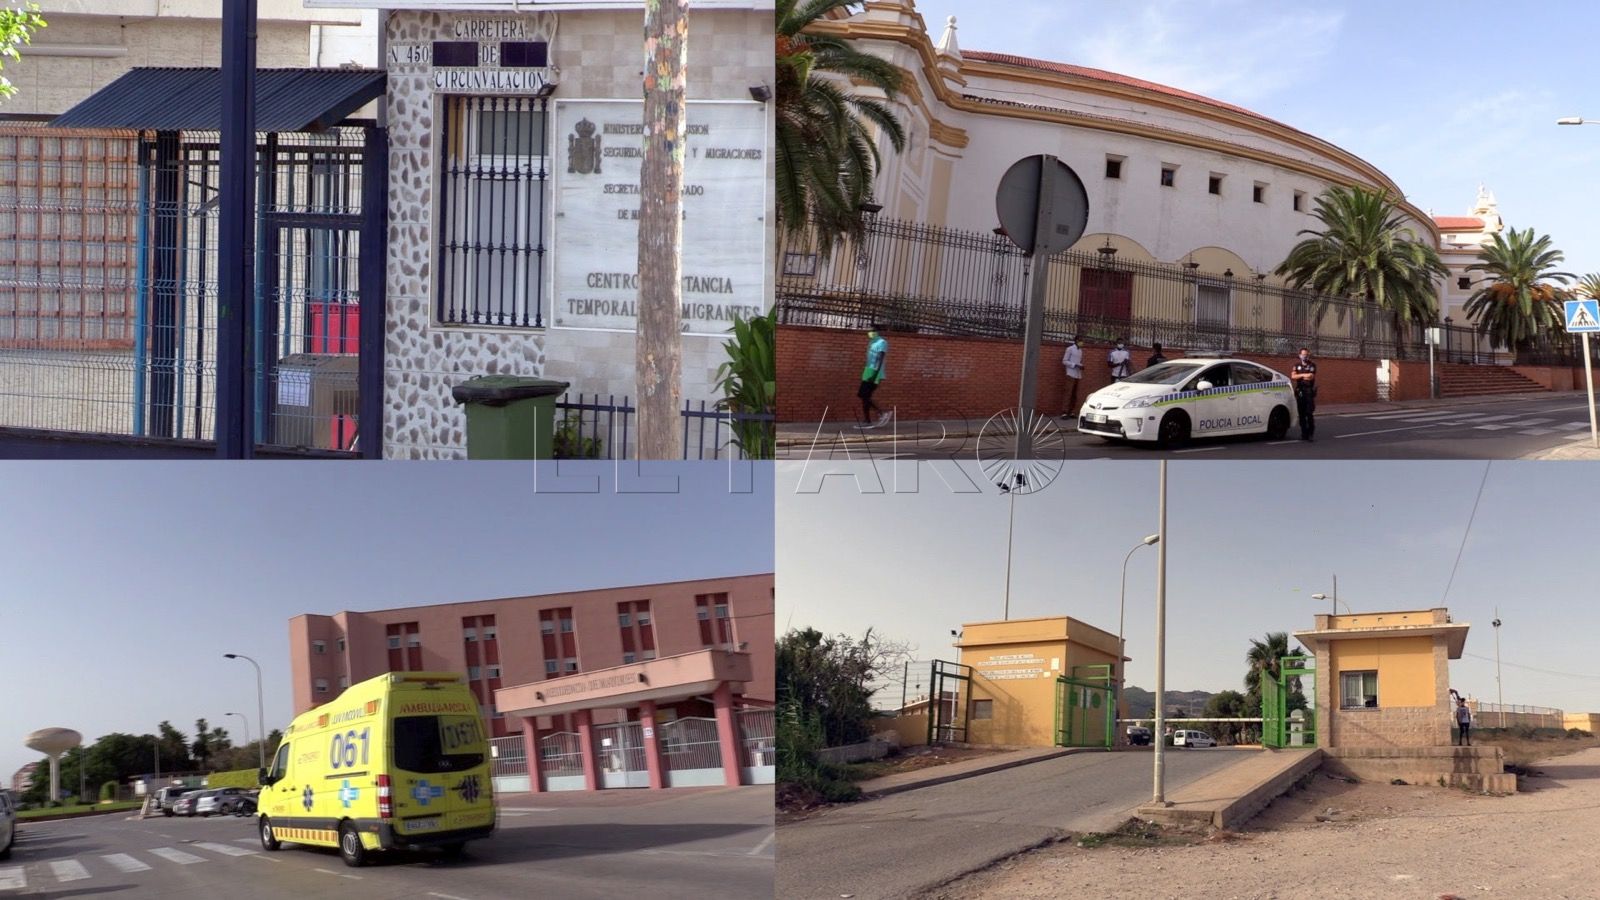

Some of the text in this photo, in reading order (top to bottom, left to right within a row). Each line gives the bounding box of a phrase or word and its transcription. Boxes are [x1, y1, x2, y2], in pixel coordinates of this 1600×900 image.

[455, 20, 525, 38] CARRETERA
[406, 45, 429, 63] 450
[482, 46, 497, 63] DE
[435, 71, 545, 89] CIRCUNVALACION
[603, 124, 643, 134] MINISTERI
[604, 147, 762, 160] SEGURIDA Y MIGRACIONES
[603, 184, 640, 194] SECRETA
[617, 209, 629, 219] DE
[683, 276, 733, 294] TANCIA
[567, 298, 638, 316] TEMPORAL
[1200, 415, 1262, 429] POLICIA LOCAL
[330, 726, 370, 769] 061
